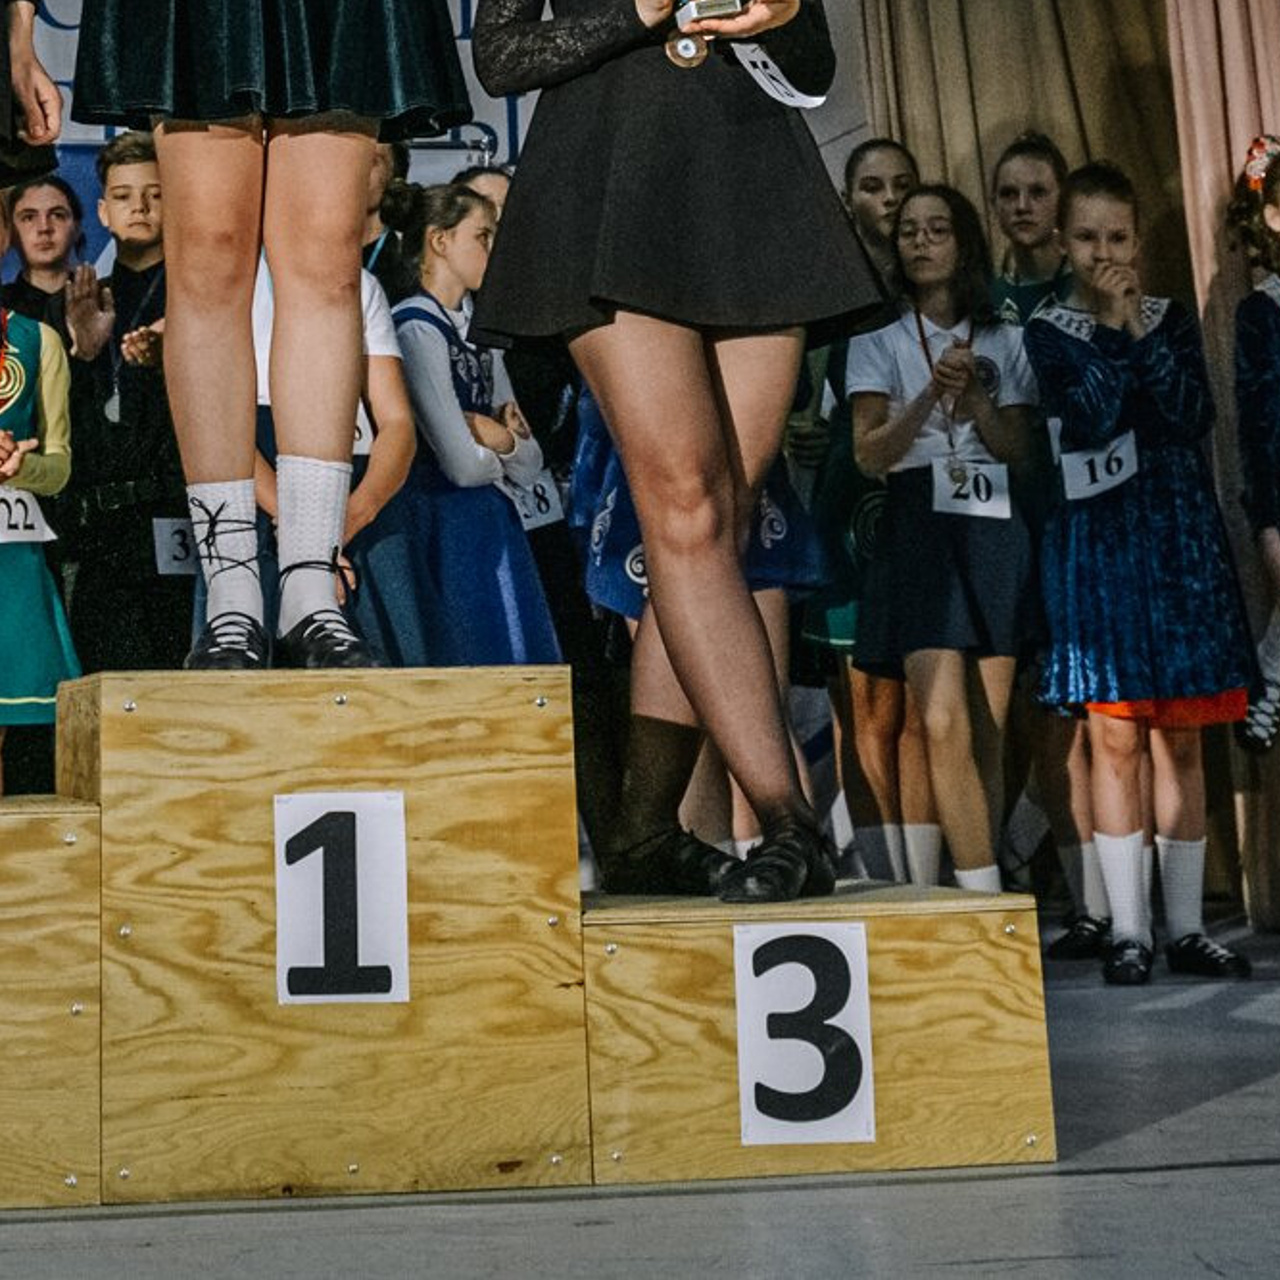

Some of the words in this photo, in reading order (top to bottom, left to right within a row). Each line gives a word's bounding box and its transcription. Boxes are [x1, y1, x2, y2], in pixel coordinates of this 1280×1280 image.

[1084, 448, 1124, 486] 16
[285, 810, 393, 996] 1
[751, 933, 864, 1123] 3
